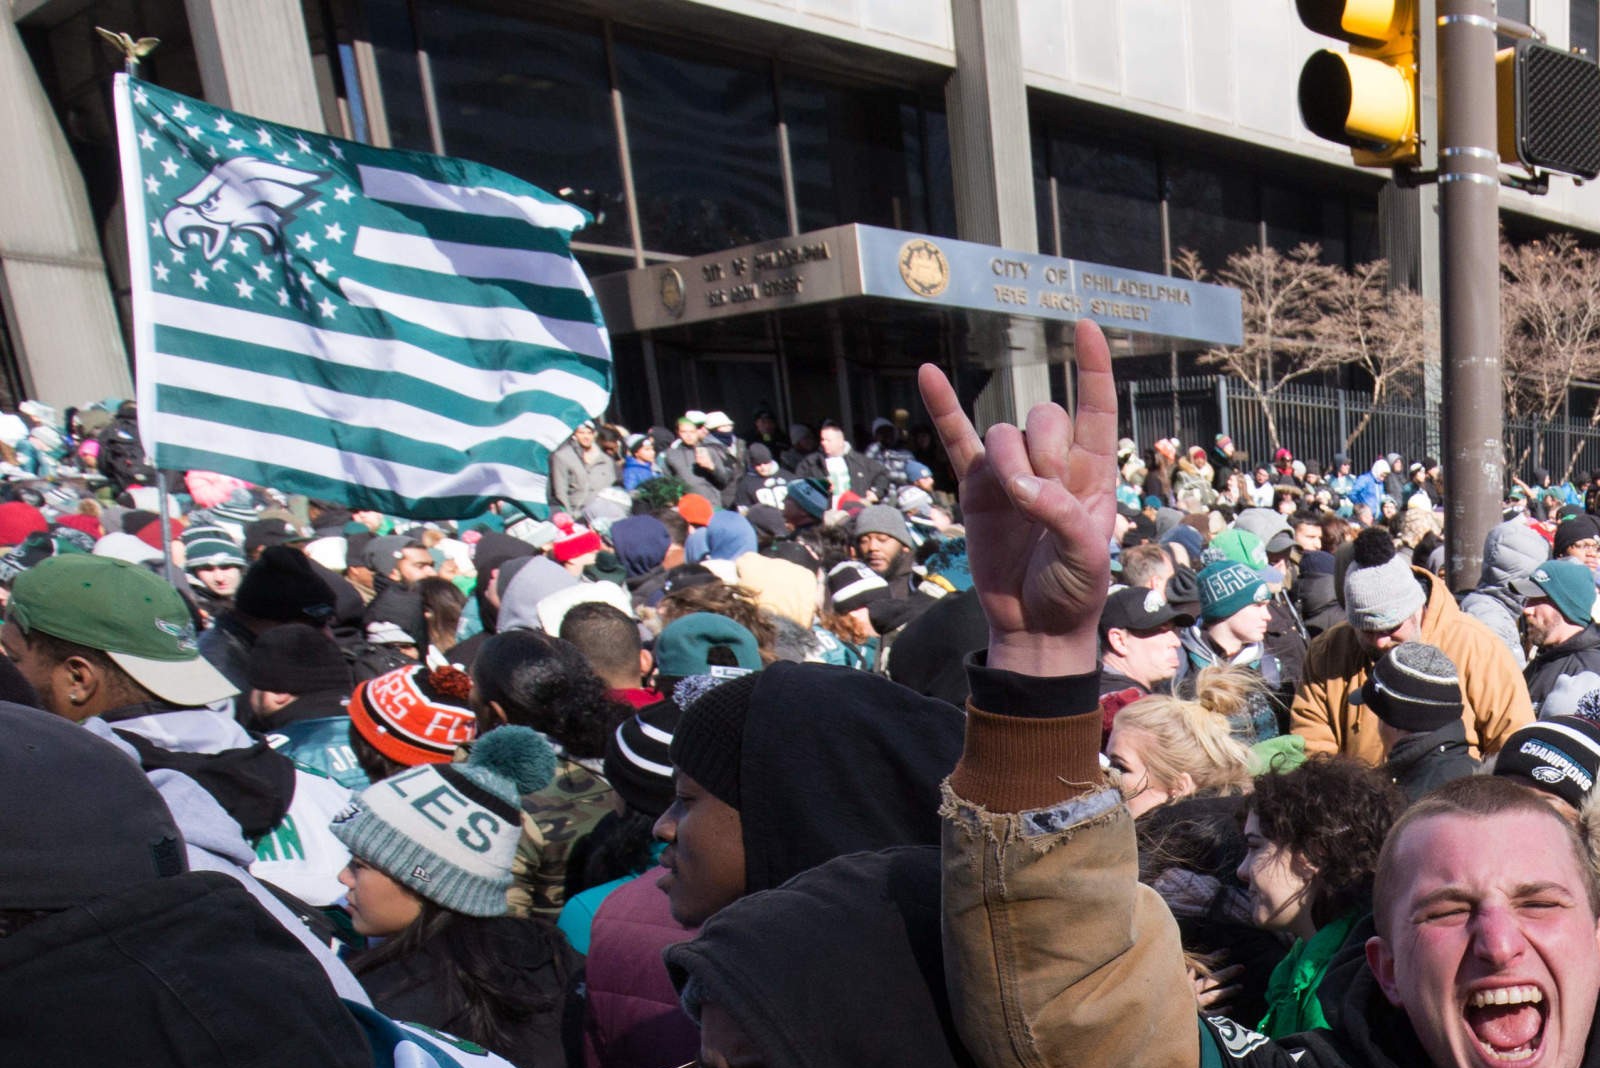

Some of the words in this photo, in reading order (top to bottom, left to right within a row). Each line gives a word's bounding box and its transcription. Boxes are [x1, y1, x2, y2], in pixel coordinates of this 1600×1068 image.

[991, 257, 1031, 280] CITY
[1045, 268, 1069, 286] OF
[1082, 272, 1192, 306] PHILADELPHIA
[994, 285, 1028, 306] 1515
[1039, 294, 1083, 314] ARCH
[1091, 302, 1152, 322] STREET
[1520, 741, 1594, 792] CHAMPIONS
